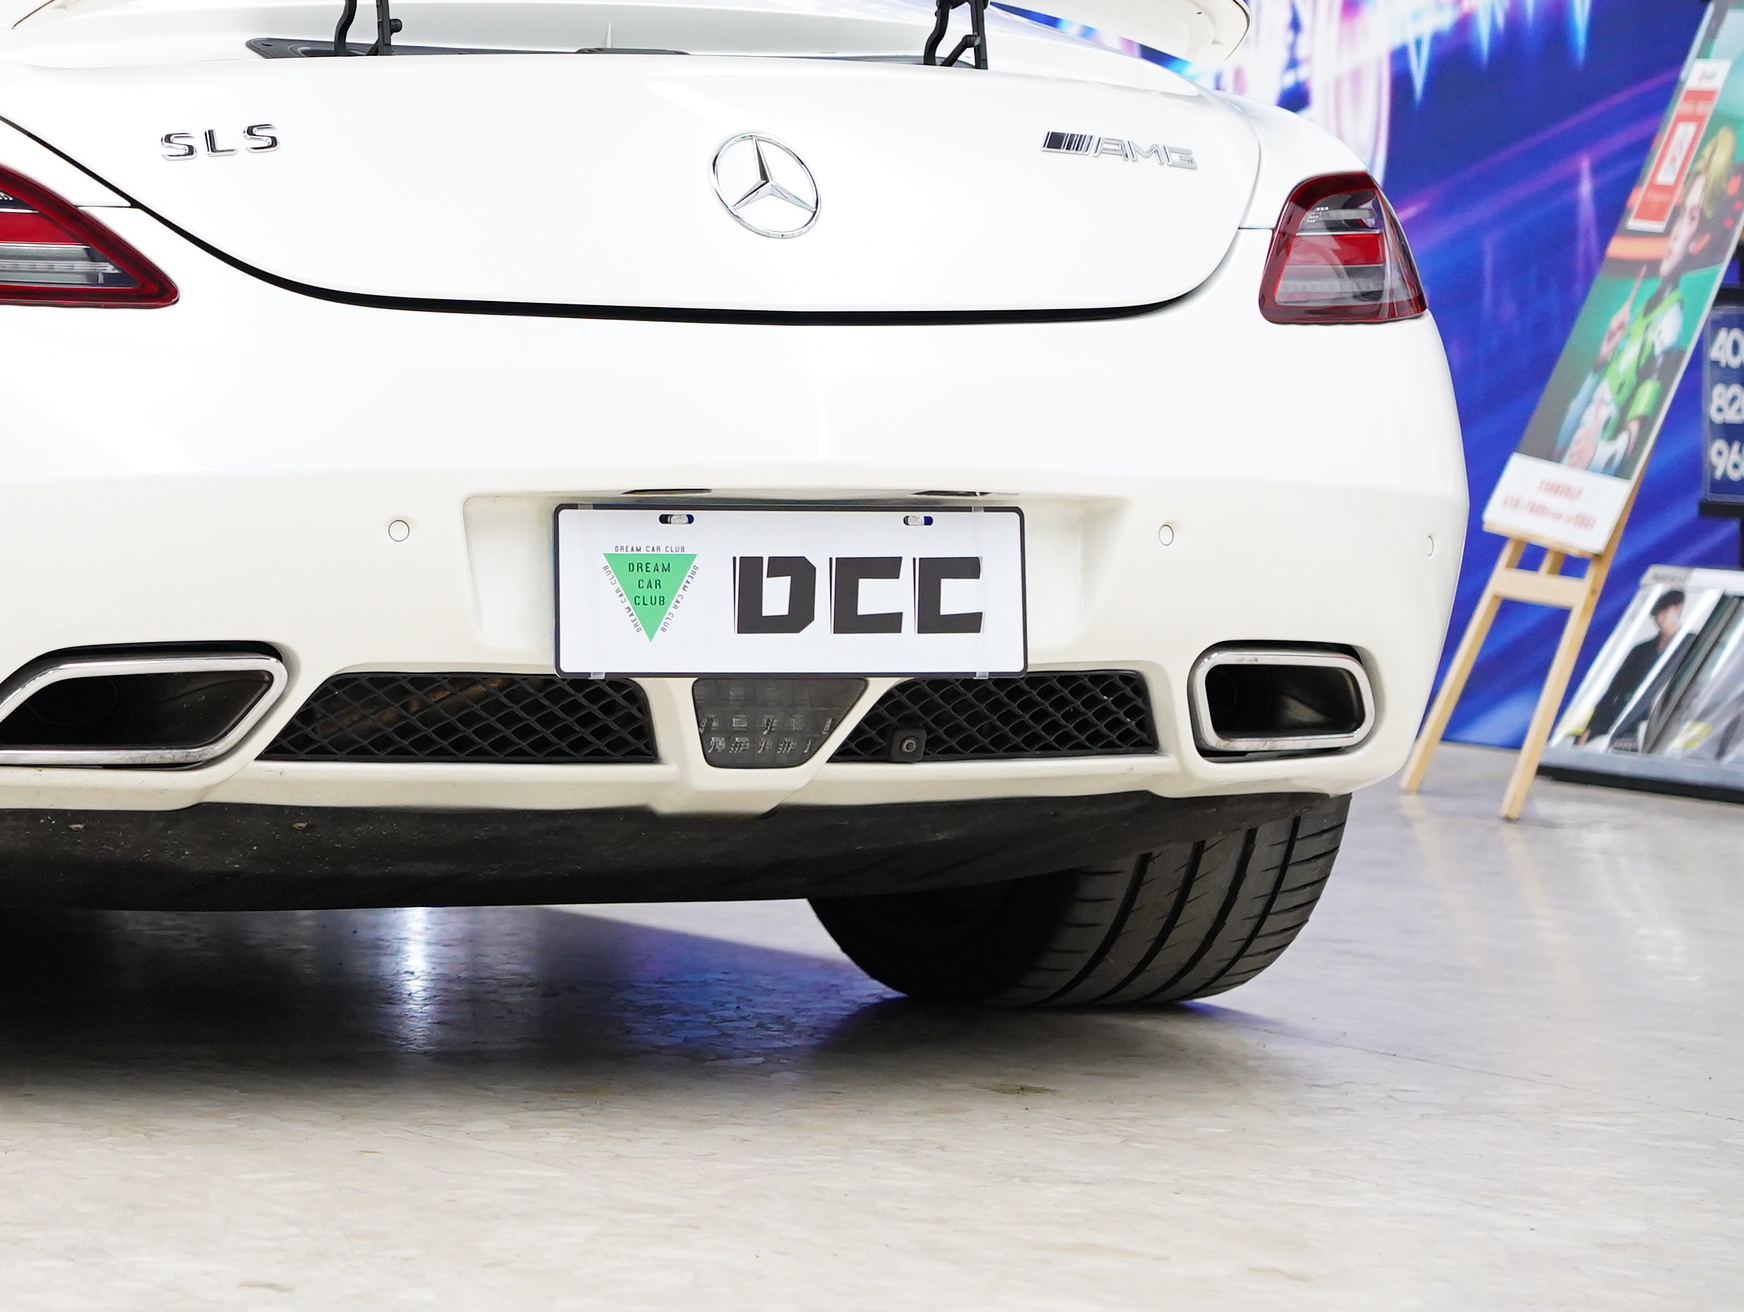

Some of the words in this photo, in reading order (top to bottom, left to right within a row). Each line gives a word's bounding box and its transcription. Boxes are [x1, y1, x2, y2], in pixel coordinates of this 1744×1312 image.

[160, 123, 281, 162] SLS
[1092, 136, 1199, 170] AMG
[614, 545, 642, 553] DREAM
[645, 545, 662, 553] CAR
[664, 545, 686, 553] CLUB
[602, 564, 617, 586] CLUB
[628, 562, 671, 573] DREAM
[681, 564, 699, 593] DREAM
[614, 586, 627, 604] CAR
[637, 578, 662, 590] CAR
[732, 554, 985, 635] DCC
[633, 595, 666, 606] CLUB
[672, 593, 684, 610] CAR
[624, 605, 643, 633] DREAM
[660, 611, 675, 633] CLUB
